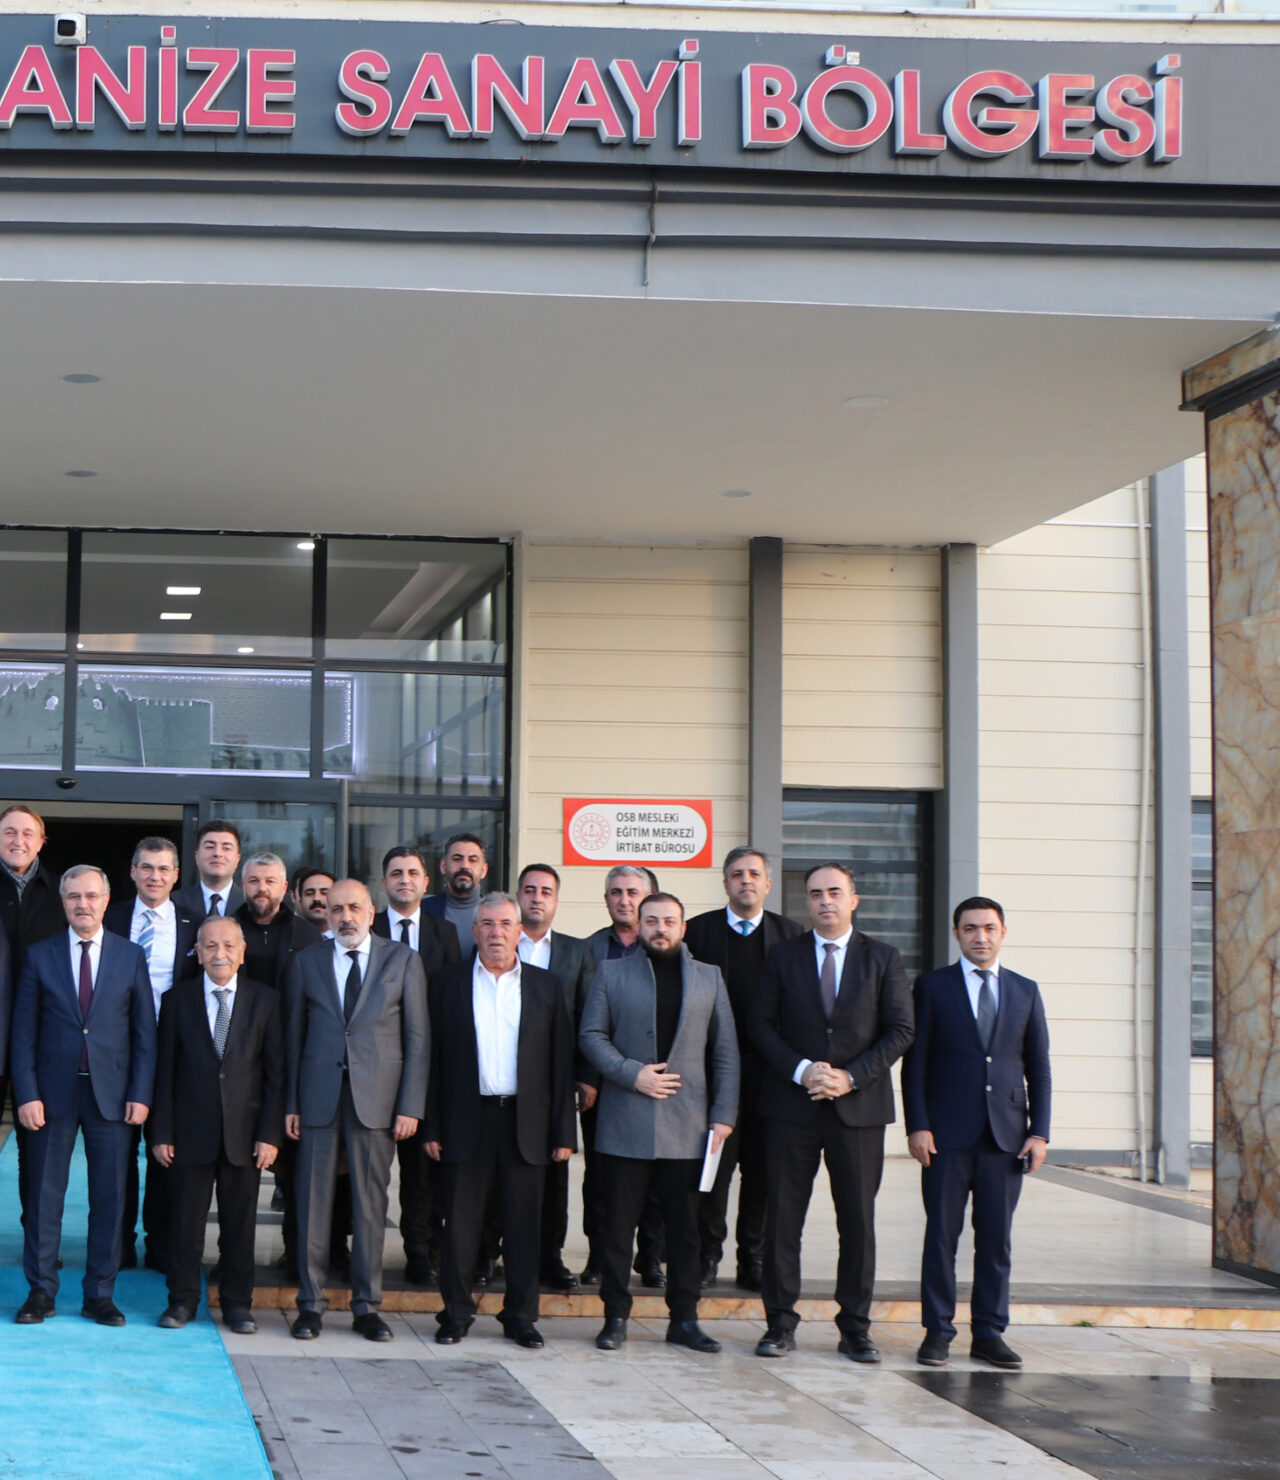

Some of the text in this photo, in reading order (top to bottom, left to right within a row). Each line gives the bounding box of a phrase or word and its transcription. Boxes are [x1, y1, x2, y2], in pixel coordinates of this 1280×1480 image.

[336, 39, 702, 146] SANAYİ
[742, 45, 1183, 162] BÖLGESİ
[616, 812, 636, 823] OSB
[616, 825, 695, 838] EĞİTİM MERKEZİ
[616, 840, 695, 854] İRTİBAT BÜROSU
